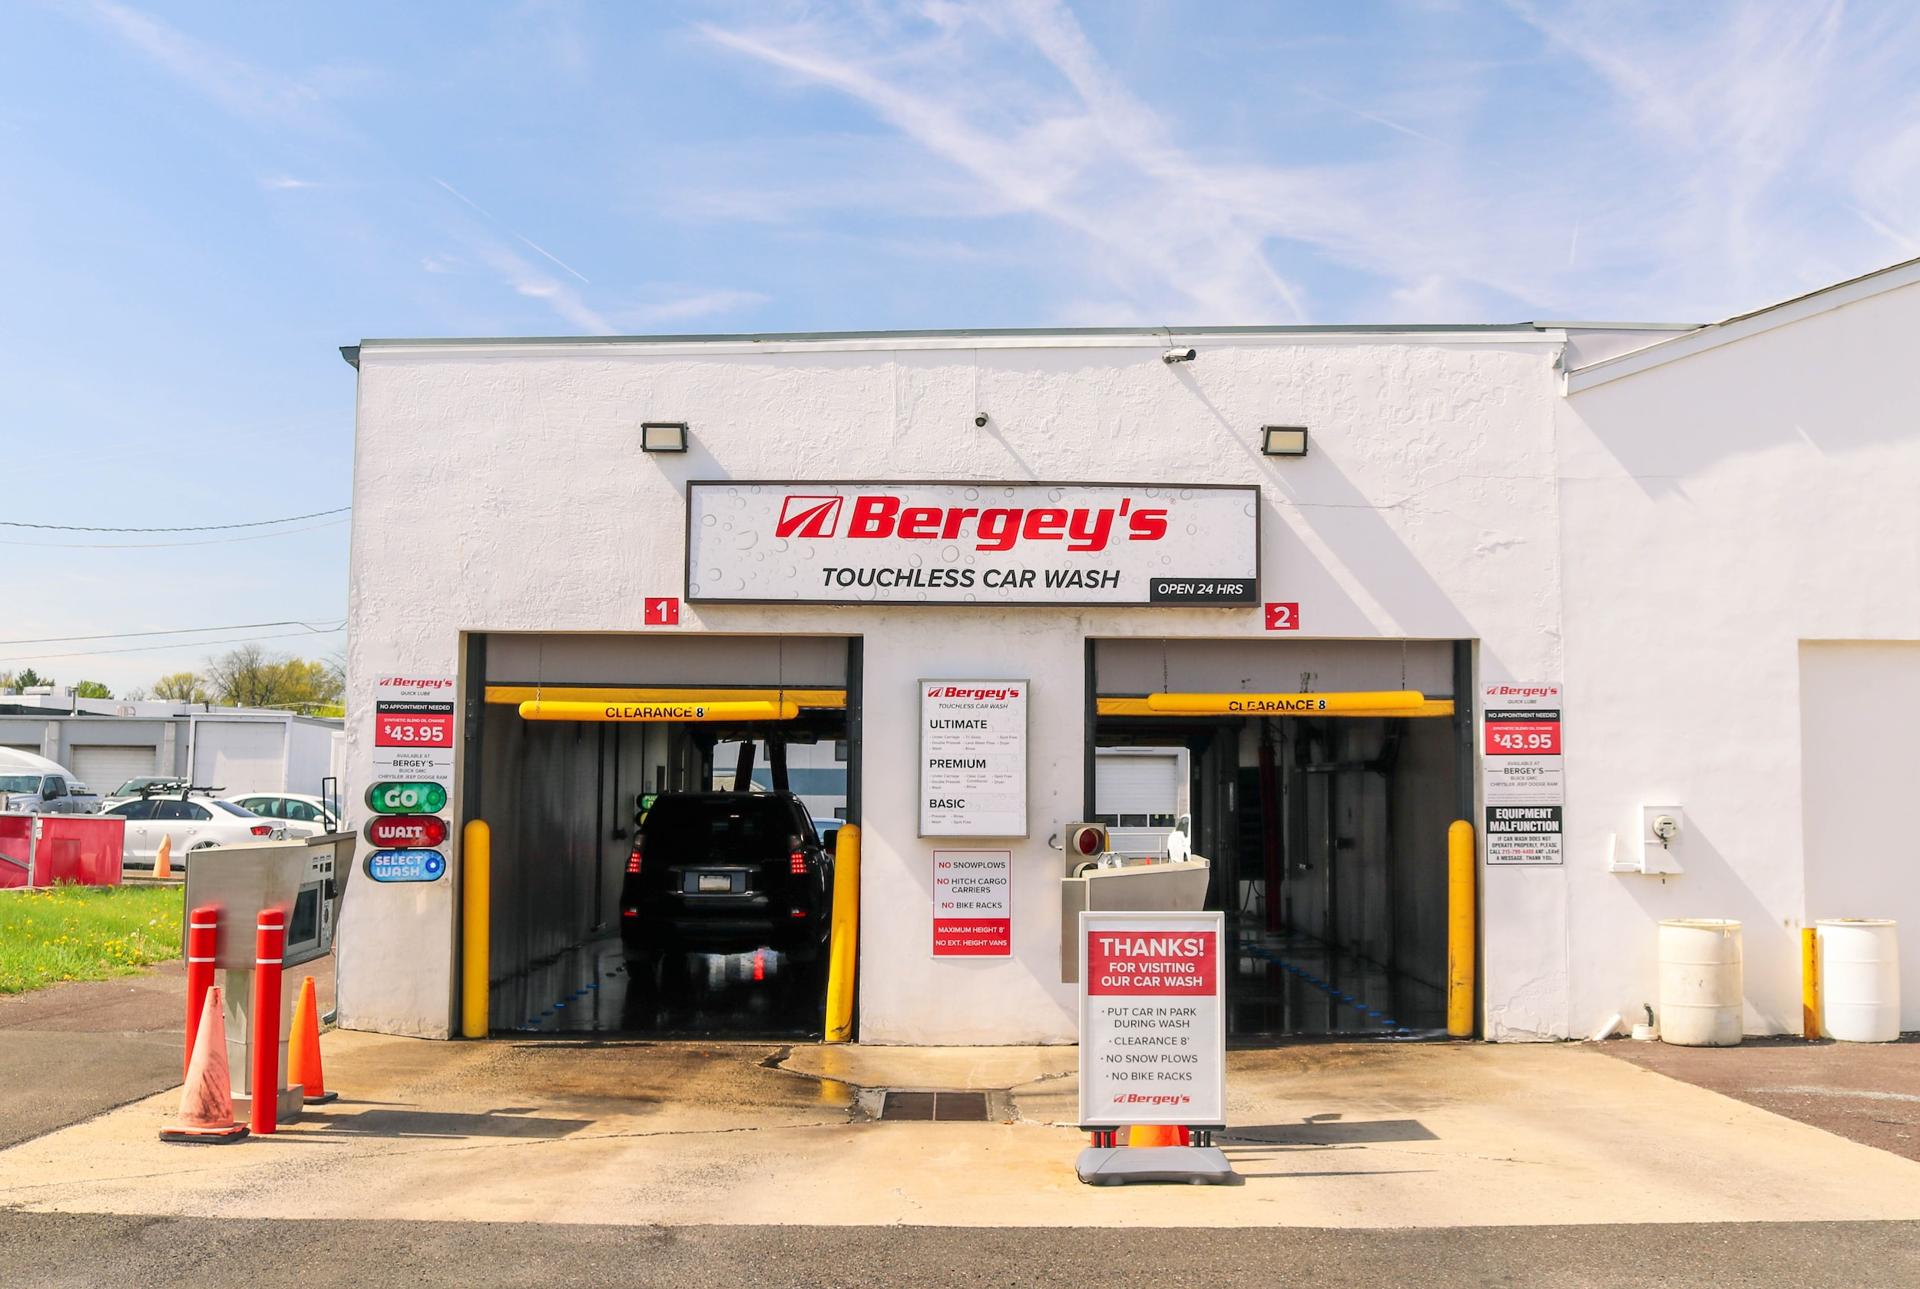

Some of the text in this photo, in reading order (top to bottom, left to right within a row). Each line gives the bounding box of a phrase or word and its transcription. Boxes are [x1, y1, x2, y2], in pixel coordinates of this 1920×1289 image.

[848, 496, 1168, 551] Bergey's
[822, 567, 1121, 588] TOUCHLESS CAR WASH
[1158, 583, 1244, 595] OPEN 24 HRS
[656, 601, 668, 622] 1
[1273, 606, 1291, 627] 2
[393, 678, 453, 688] Bergey's
[945, 687, 1019, 700] Bergey's
[1500, 687, 1557, 697] Bergey's
[1229, 700, 1326, 711] CLEARANCE 8
[605, 707, 692, 718] CLEARANCE
[930, 720, 987, 728] ULTIMATE
[385, 725, 443, 741] $43.95
[1494, 734, 1552, 748] $43.95
[929, 760, 986, 768] PREMIUM
[384, 790, 418, 807] GO
[929, 799, 965, 808] BASIC
[1496, 808, 1552, 819] EQUIPMENT
[1490, 821, 1559, 831] MALFUNCTION
[378, 827, 423, 838] WAIT
[375, 855, 423, 866] SELECT
[376, 866, 420, 877] WASH
[1099, 938, 1204, 957] THANKS!
[1109, 963, 1195, 973] FOR VISITING
[1101, 976, 1203, 987] OUR CAR WASH
[1107, 1008, 1197, 1016] PUT CAR IN PARK
[1114, 1020, 1190, 1028] DURING WASH
[1114, 1037, 1190, 1045] CLEARANCE 8'
[1106, 1055, 1198, 1063] NO SNOW PLOWS
[1112, 1072, 1192, 1080] NO BIKE RACKS
[1127, 1094, 1190, 1105] Bergey's
